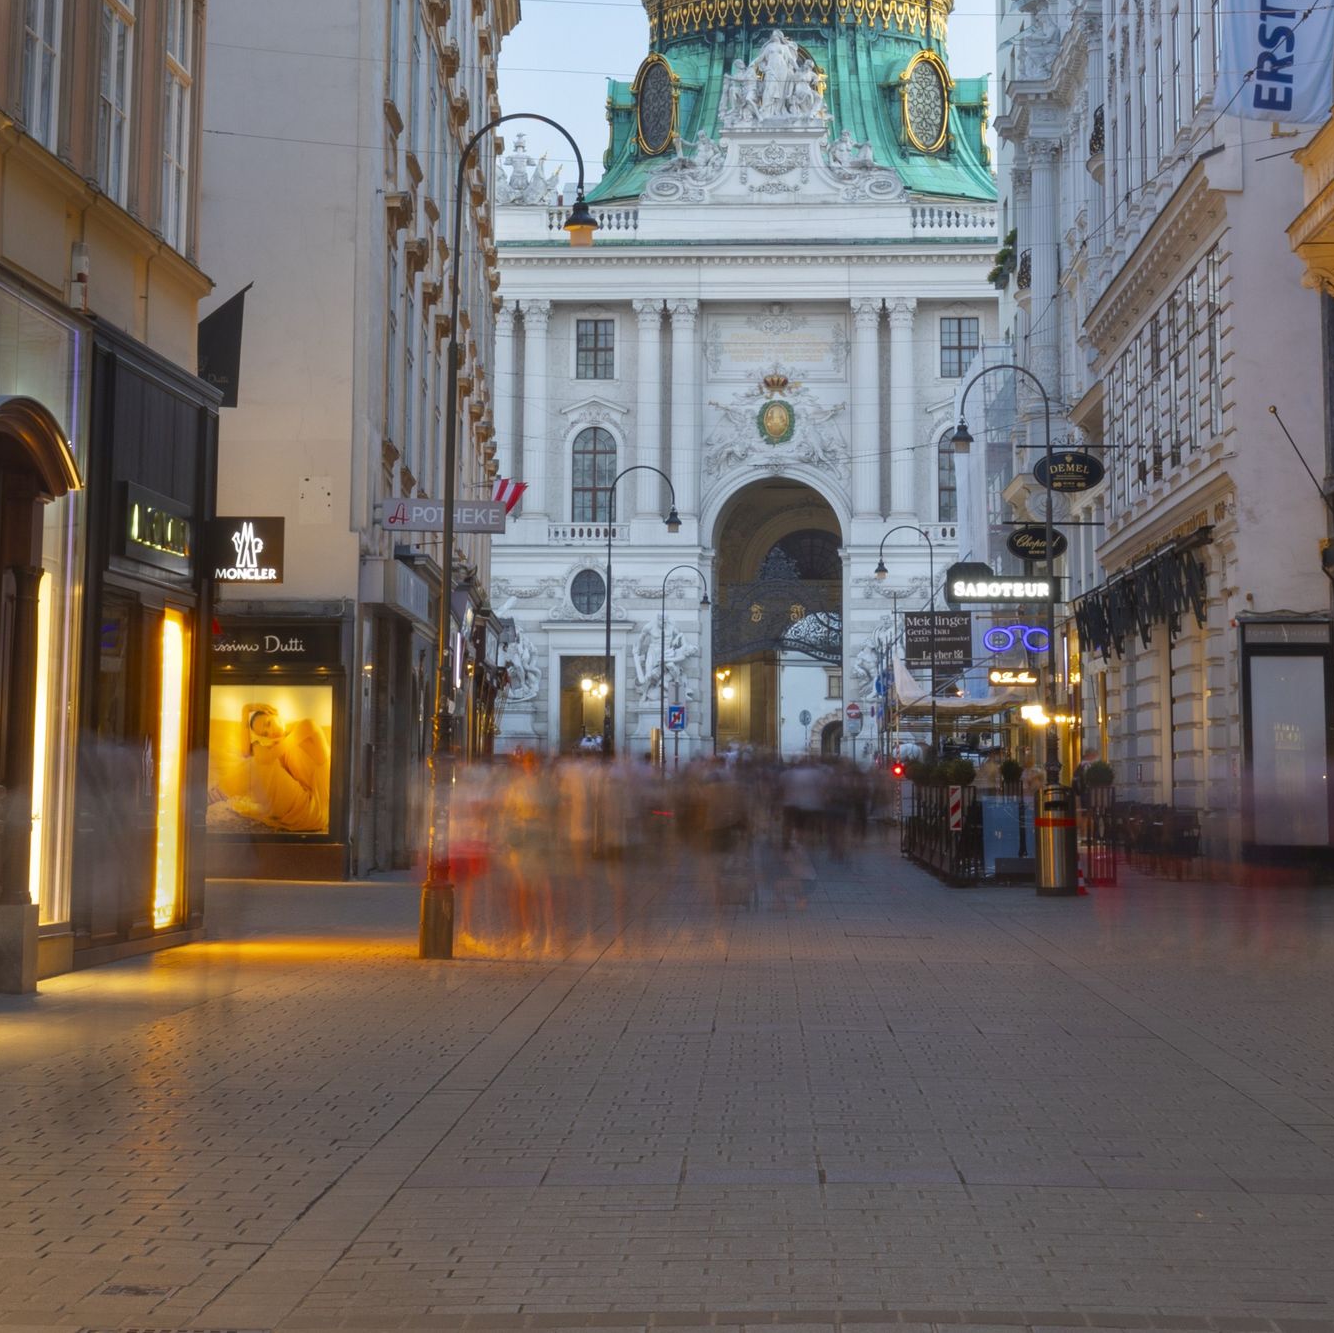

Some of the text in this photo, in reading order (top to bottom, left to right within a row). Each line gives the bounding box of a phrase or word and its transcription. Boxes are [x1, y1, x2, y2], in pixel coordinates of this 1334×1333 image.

[1049, 463, 1090, 474] DEMEL
[214, 568, 277, 581] MONCLER
[953, 580, 1049, 597] SABOTEUR
[264, 634, 305, 653] Dutti
